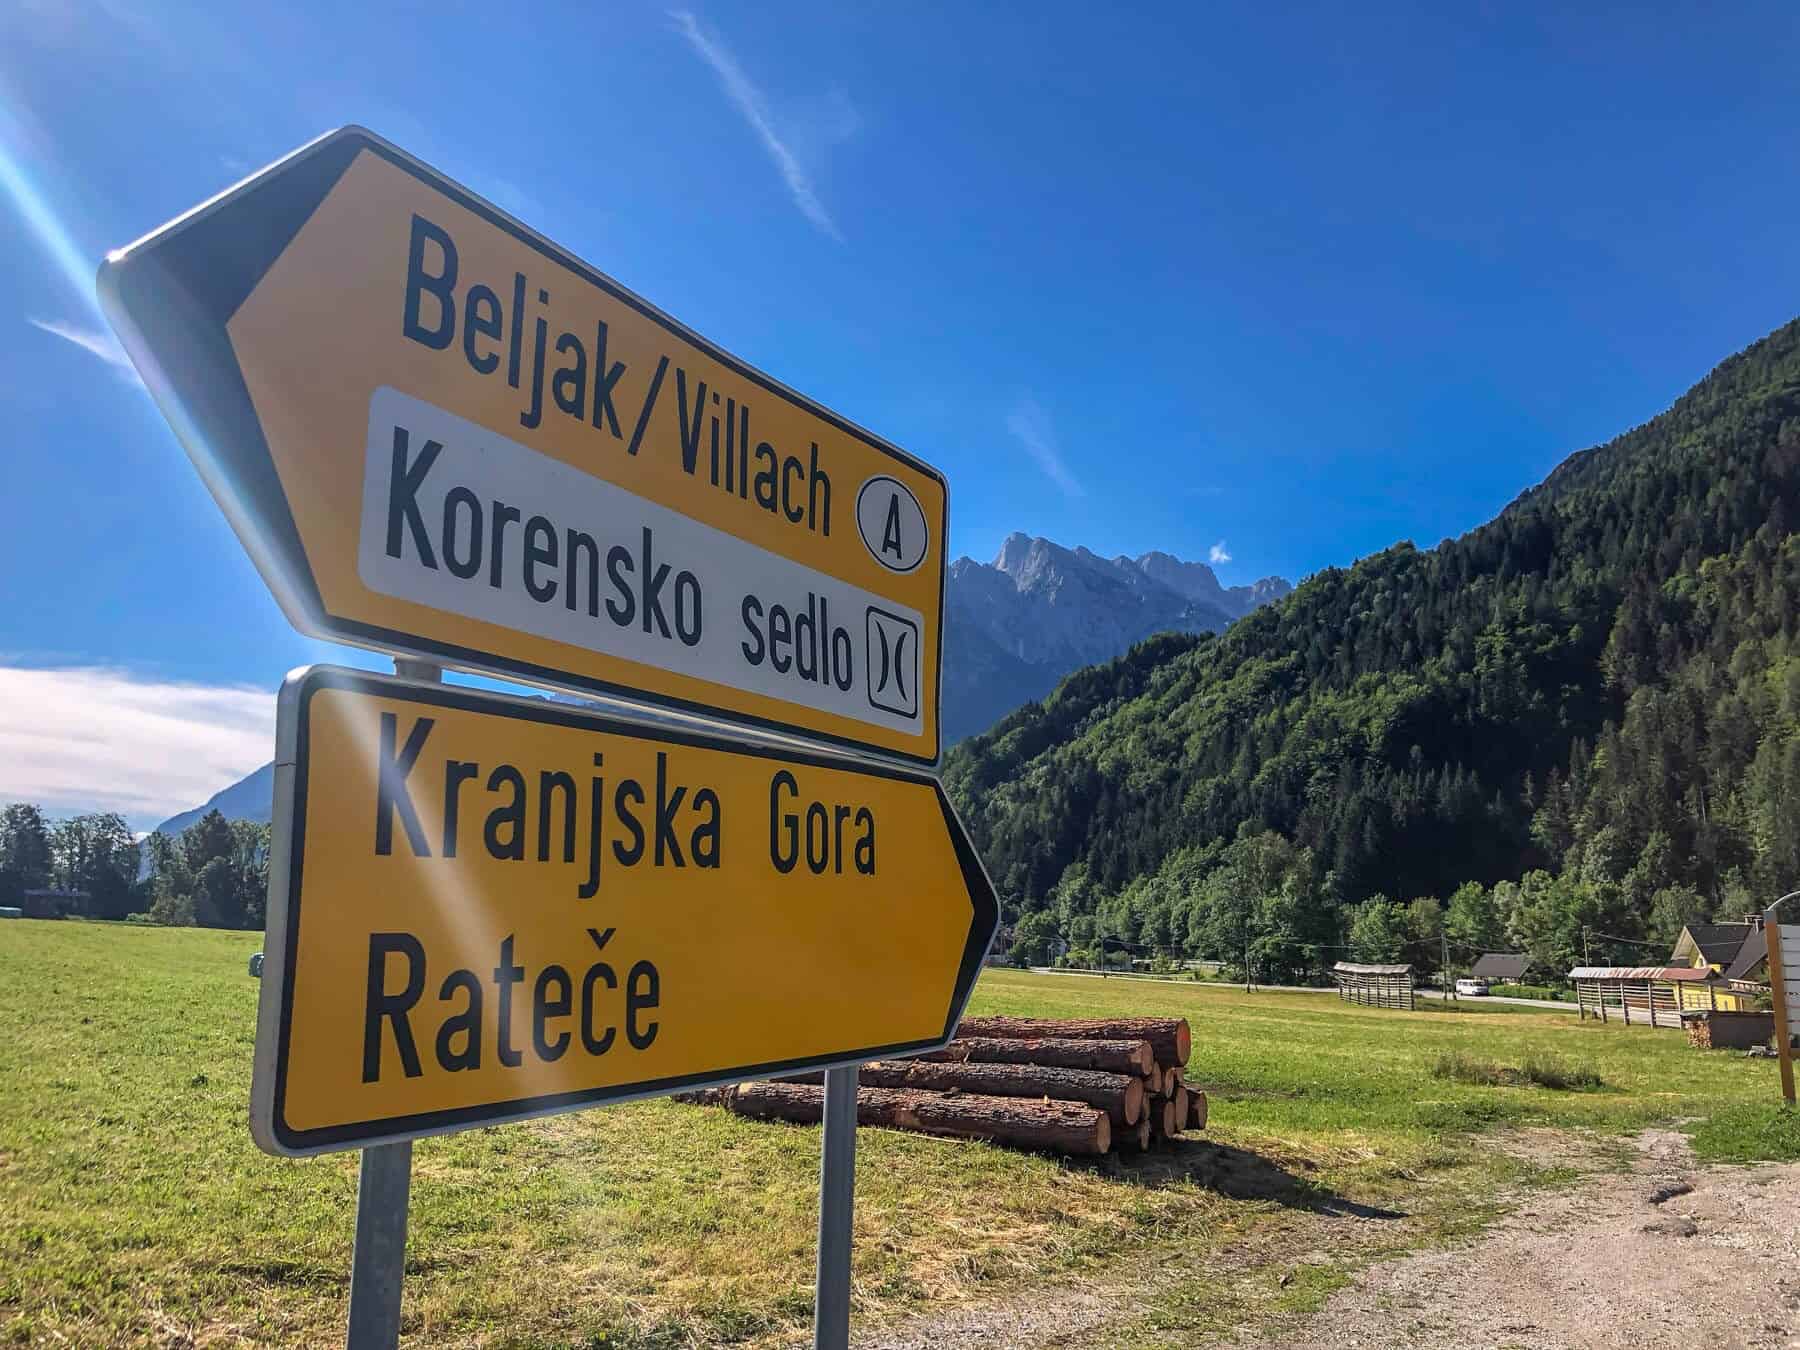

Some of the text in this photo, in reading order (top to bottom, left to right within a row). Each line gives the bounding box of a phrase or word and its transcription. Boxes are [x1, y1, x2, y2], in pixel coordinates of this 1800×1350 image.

[403, 213, 831, 536] Beljak/Villach
[386, 425, 853, 691] Korensko sedlo
[881, 493, 904, 559] A
[375, 712, 876, 899] Kranjska Gora
[362, 927, 660, 1083] Rateče
